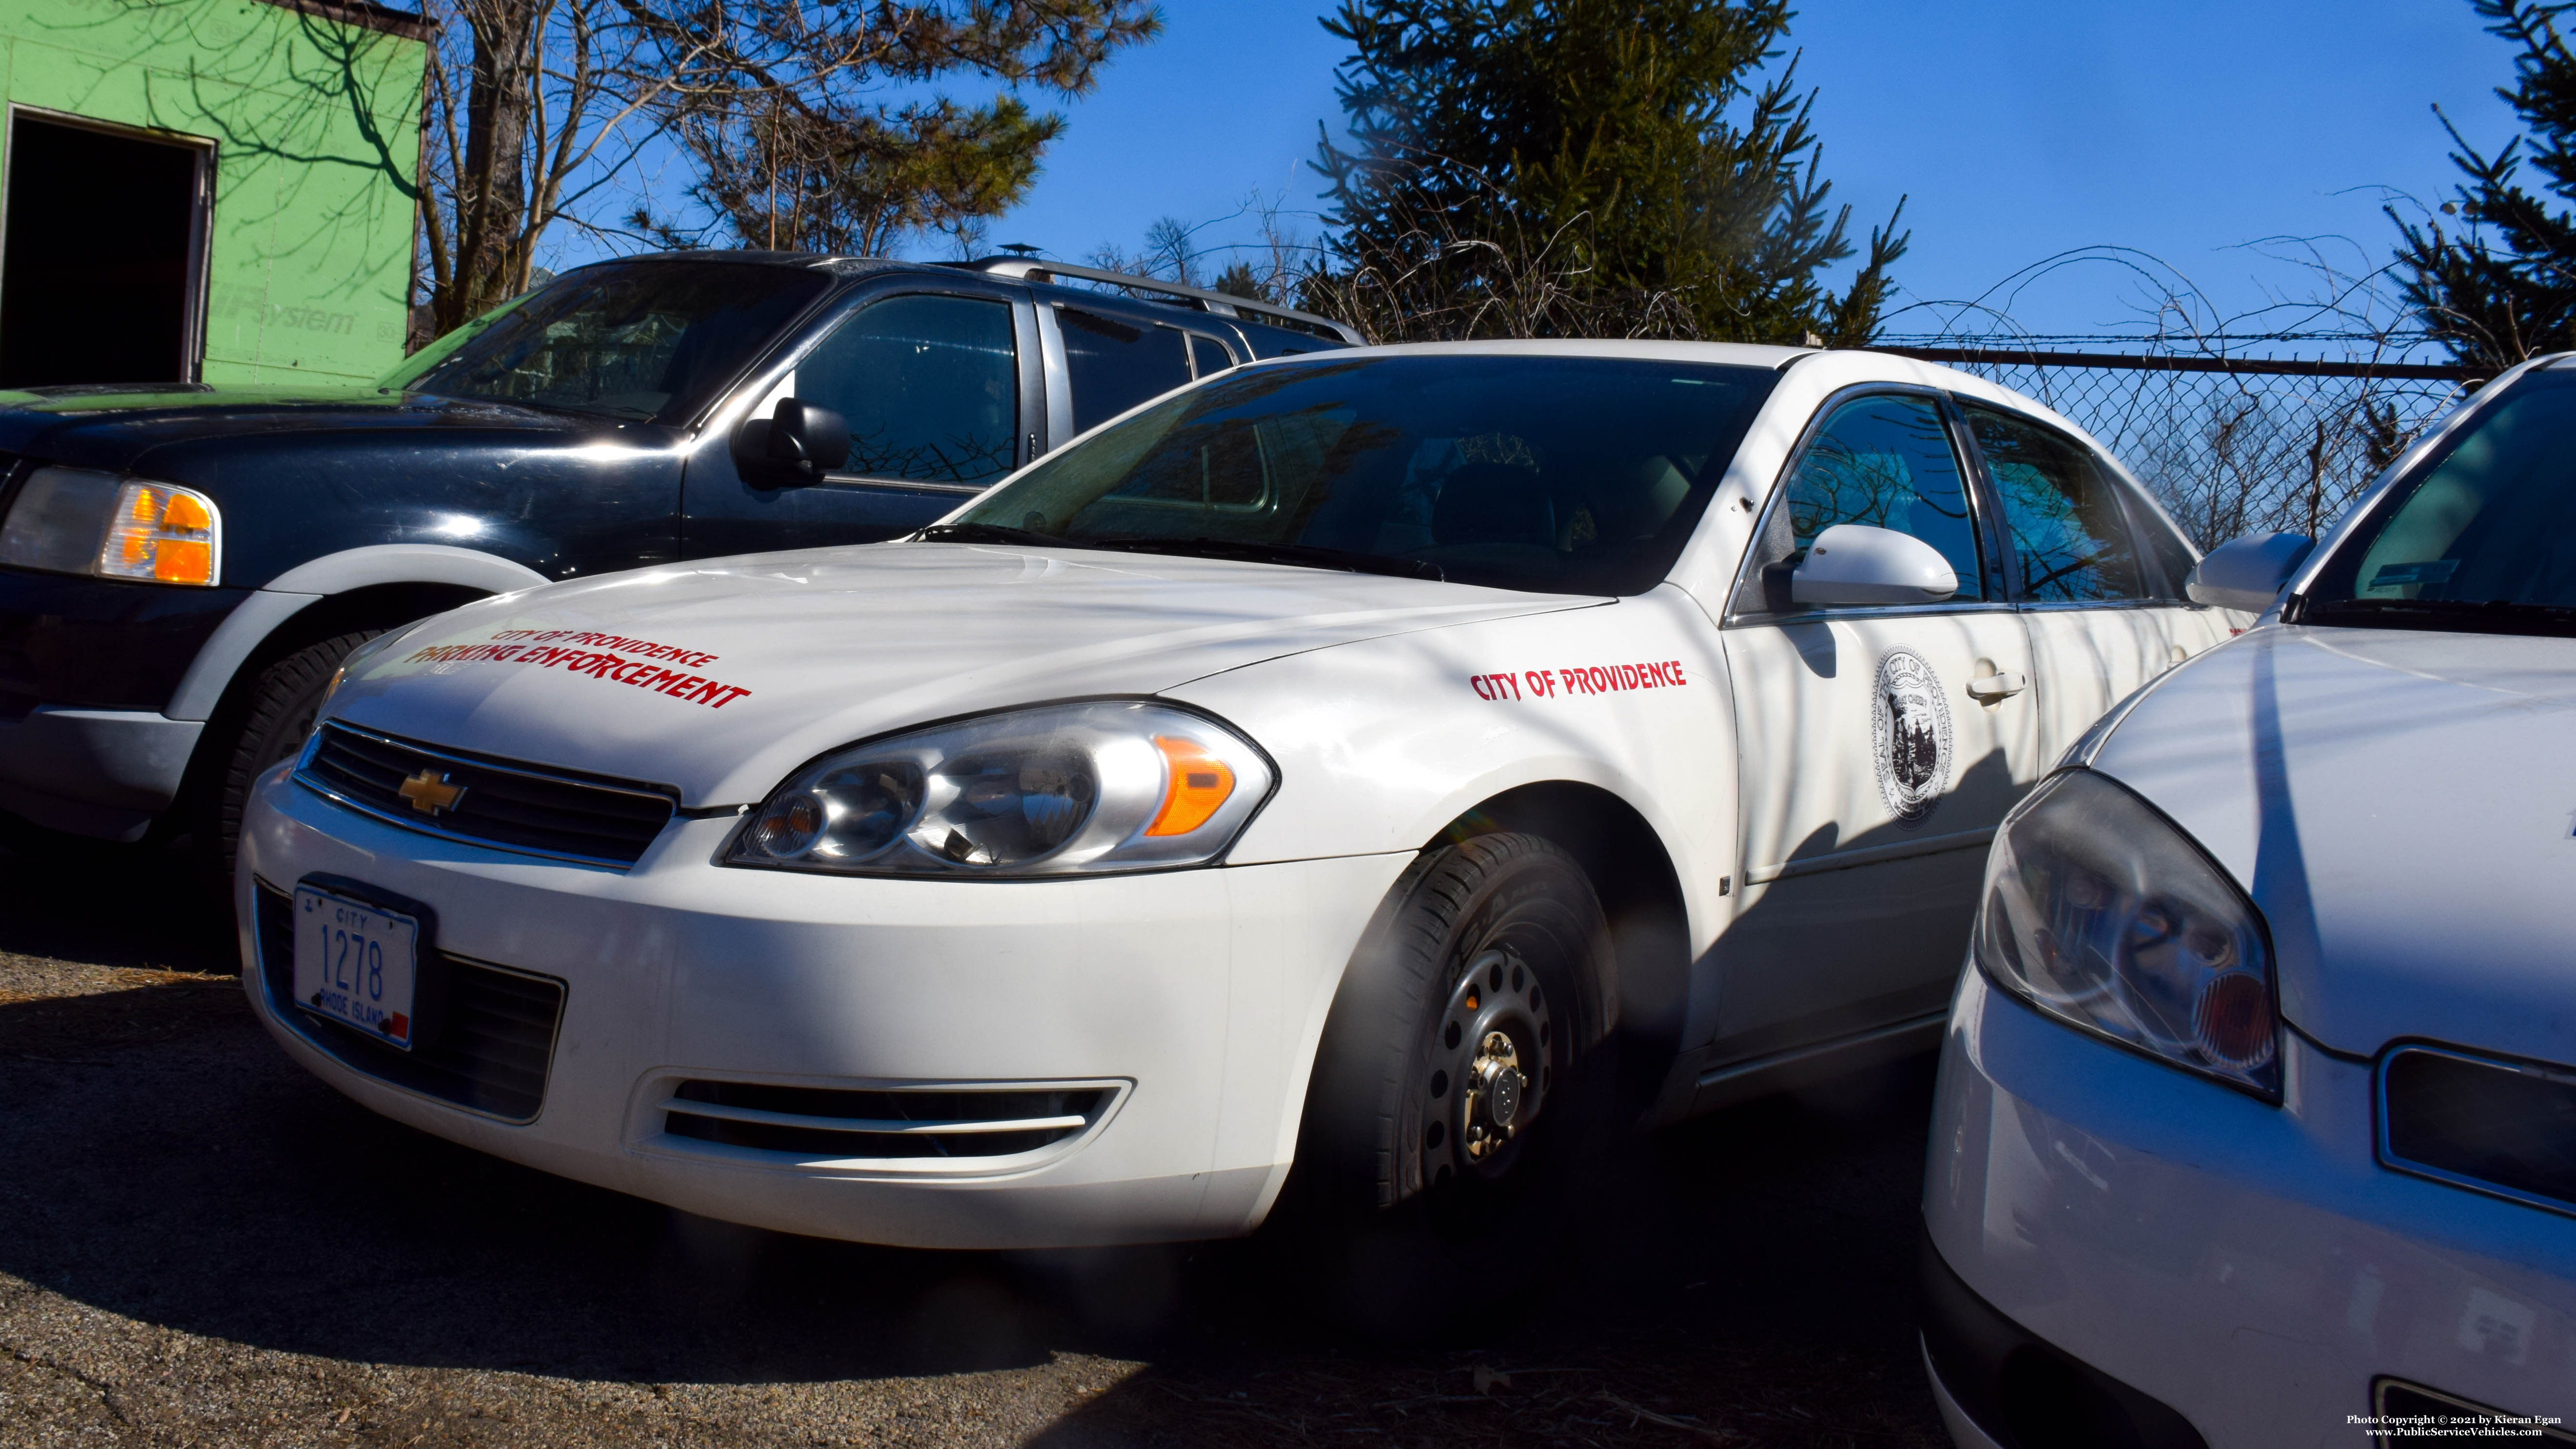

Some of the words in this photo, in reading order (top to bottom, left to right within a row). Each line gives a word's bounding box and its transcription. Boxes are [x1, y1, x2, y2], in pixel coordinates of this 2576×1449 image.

[490, 630, 543, 641] CITY
[533, 630, 573, 642] OF
[563, 632, 719, 668] PROVIDENCE
[1889, 656, 1906, 675] CITY
[1909, 659, 1920, 675] OF
[402, 645, 527, 664] PARKING
[512, 645, 753, 709] ENFORCEMENT
[1470, 672, 1521, 702] CITY
[1524, 670, 1556, 699] OF
[1558, 660, 1687, 696] PROVIDENCE
[1879, 670, 1892, 700] THE
[1877, 706, 1884, 731] OF
[1922, 670, 1948, 776] PROVIDENCE
[1878, 737, 1890, 783] SEAL
[336, 908, 368, 930] CITY
[322, 924, 382, 1001] 1278
[320, 988, 348, 1015] RHODE
[352, 1001, 384, 1026] ISLAND
